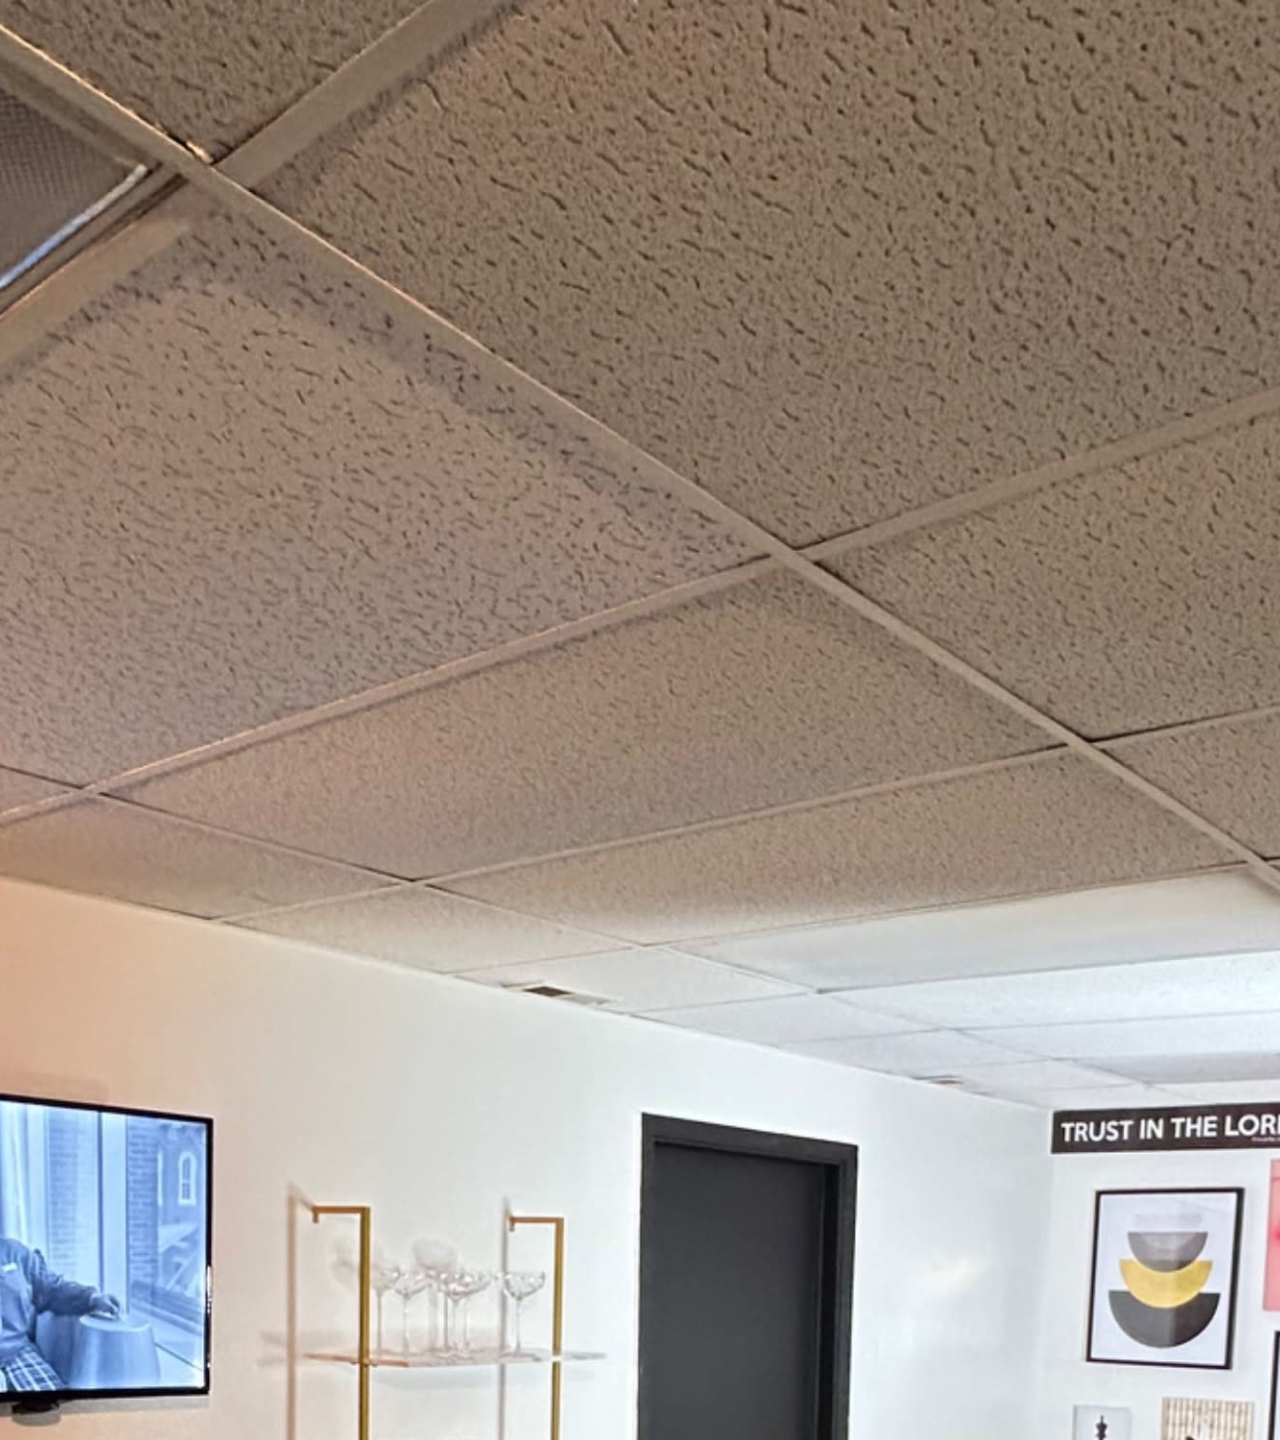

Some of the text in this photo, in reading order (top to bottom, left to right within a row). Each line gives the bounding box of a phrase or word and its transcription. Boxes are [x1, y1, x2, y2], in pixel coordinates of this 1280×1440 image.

[1060, 1120, 1134, 1142] TRUST
[1139, 1118, 1164, 1140] IN
[1170, 1116, 1218, 1138] THE
